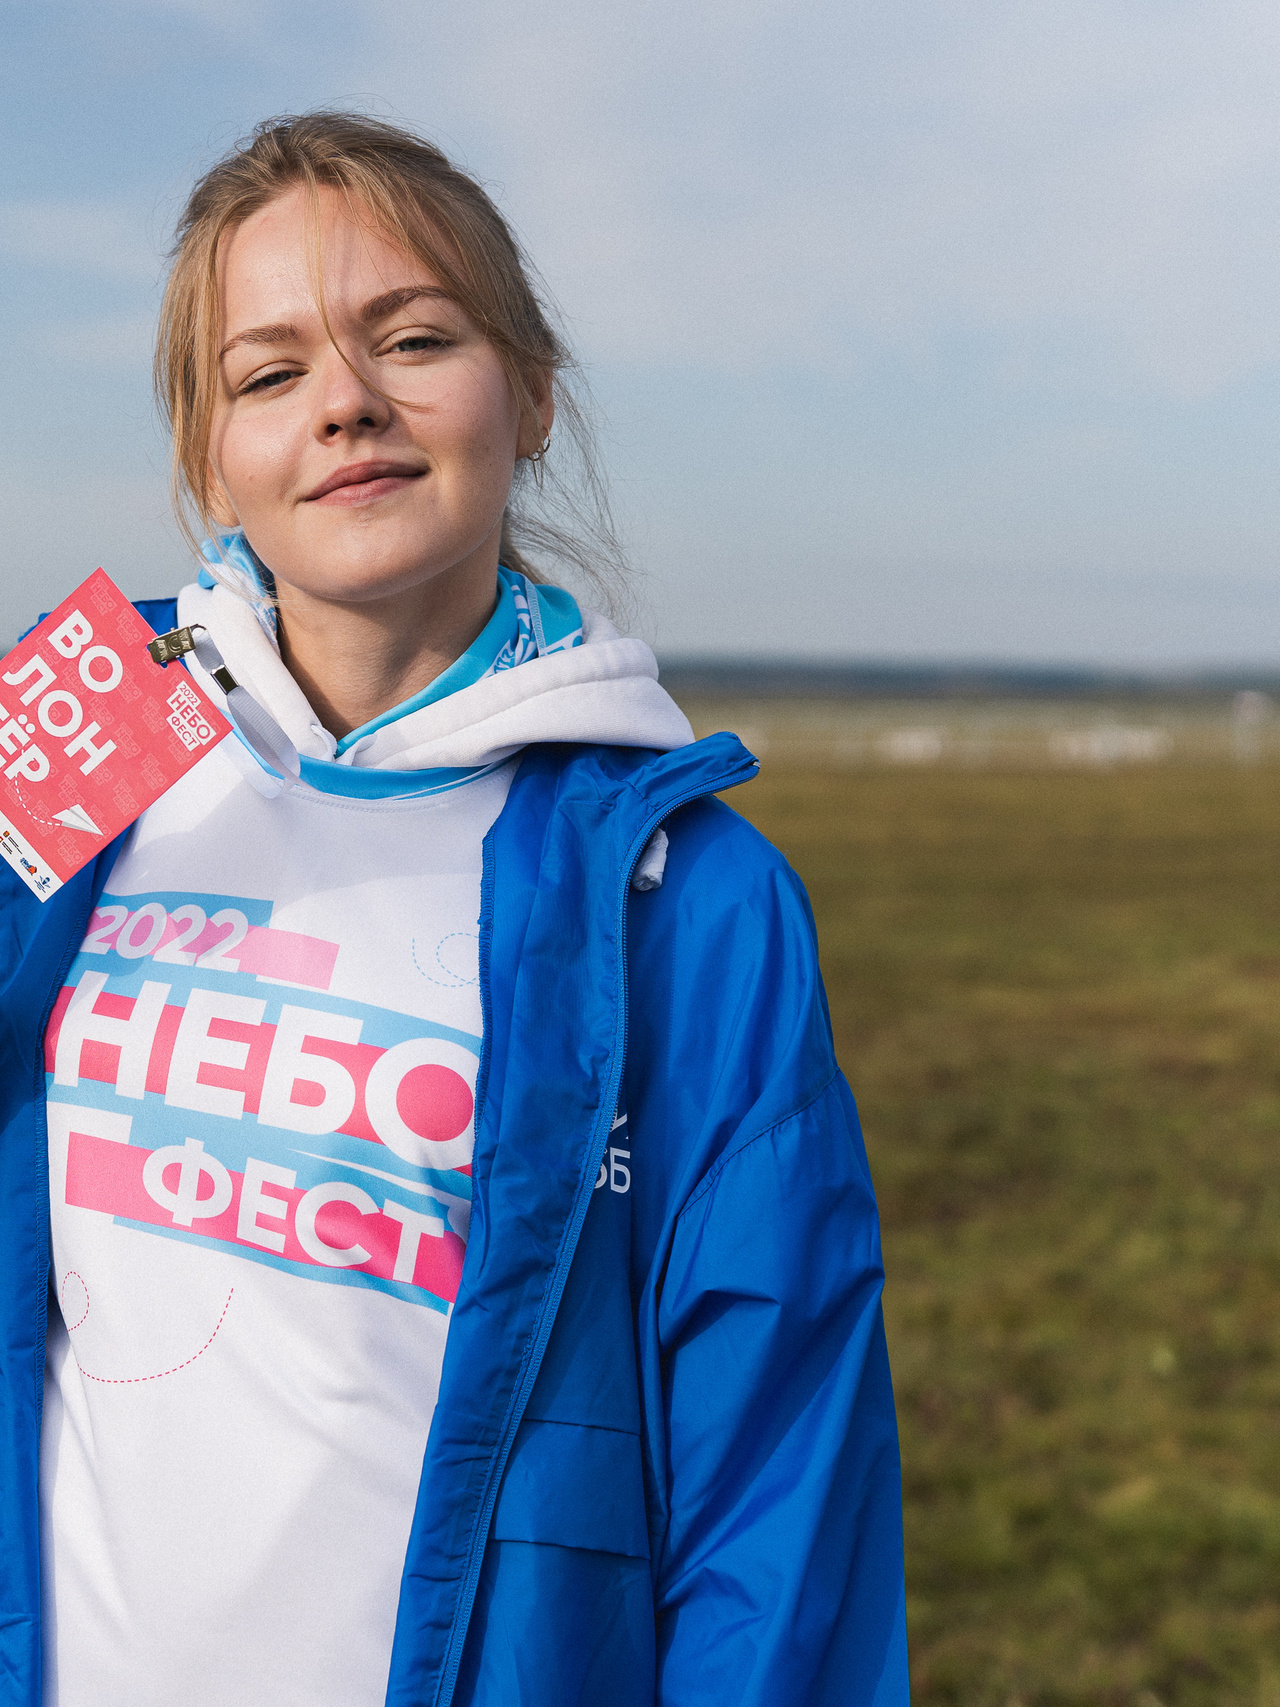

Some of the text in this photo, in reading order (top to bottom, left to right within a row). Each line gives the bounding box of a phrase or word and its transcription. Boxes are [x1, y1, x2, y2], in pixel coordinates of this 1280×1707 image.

[46, 609, 123, 693] ВО
[1, 653, 117, 776] ЛОН
[122, 678, 141, 698] ЕБО
[170, 693, 210, 739] НЕБО
[179, 684, 198, 705] 2022
[171, 716, 197, 746] ФЕСТ
[80, 903, 249, 974] 2022
[54, 970, 480, 1171] НЕБО
[142, 1137, 445, 1284] ФЕСТ
